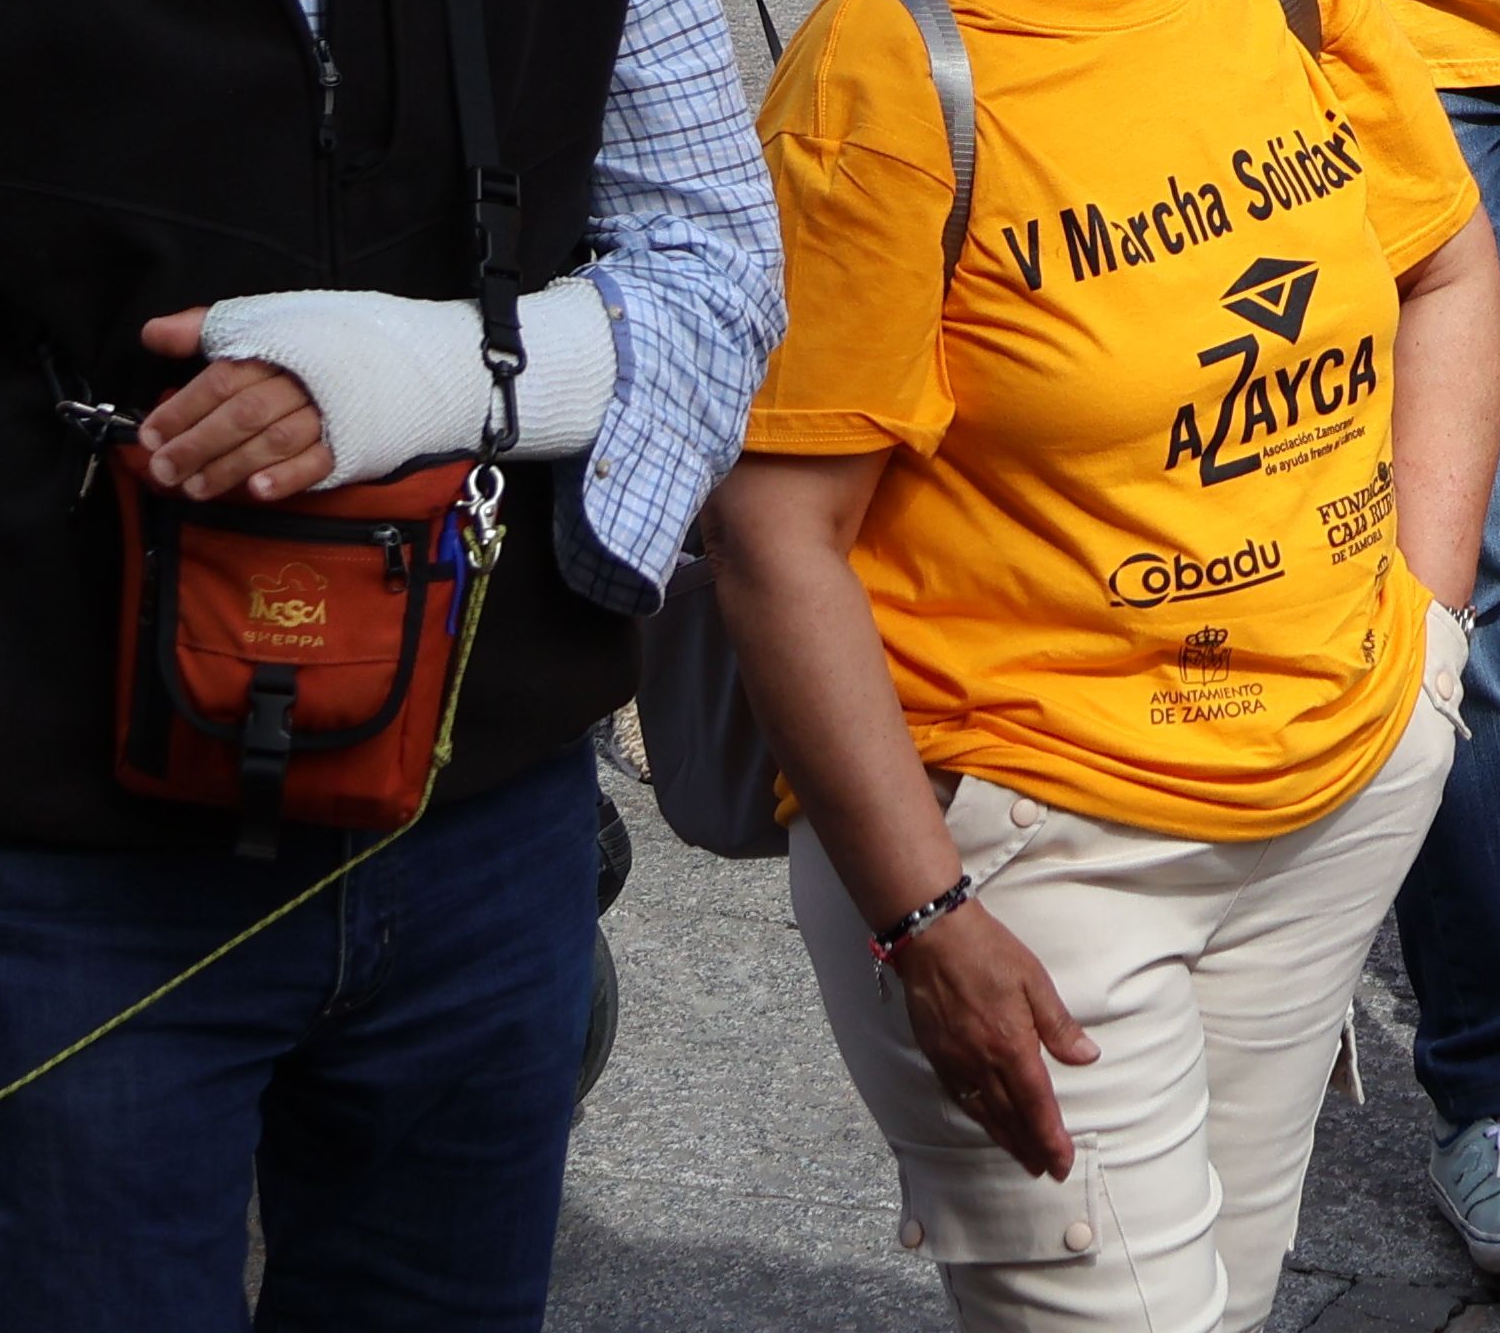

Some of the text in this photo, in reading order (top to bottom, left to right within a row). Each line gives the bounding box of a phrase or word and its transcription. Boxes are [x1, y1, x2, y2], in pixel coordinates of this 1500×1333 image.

[1001, 175, 1230, 295] V Marcha
[1164, 334, 1378, 490] AZAYCA
[1108, 537, 1286, 609] Cobadu
[1149, 683, 1264, 706] AYUNTAMIENTO
[1149, 698, 1268, 725] DE ZAMORA
